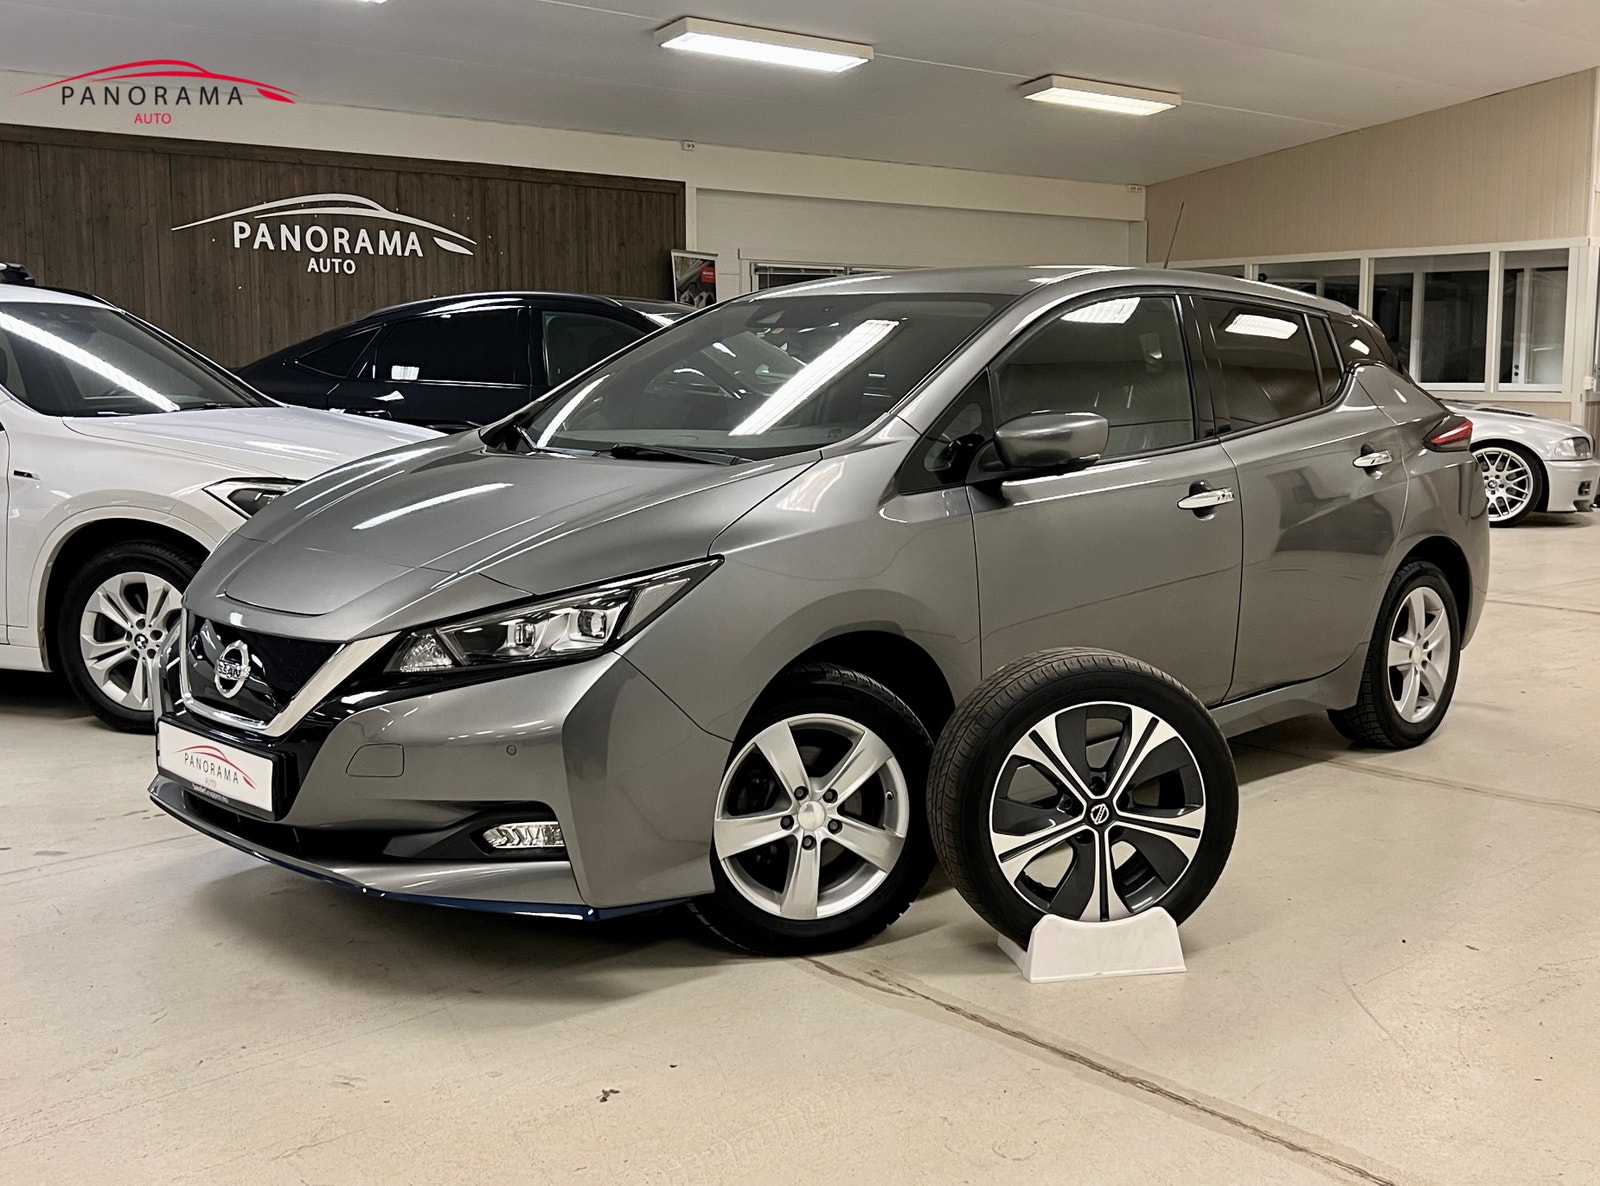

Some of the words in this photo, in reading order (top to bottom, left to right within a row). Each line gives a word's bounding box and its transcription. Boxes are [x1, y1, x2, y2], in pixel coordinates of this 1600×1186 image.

[233, 221, 424, 258] PANORAMA
[307, 257, 356, 275] AUTO
[217, 660, 242, 678] SSAN
[184, 752, 239, 785] PANORAMA
